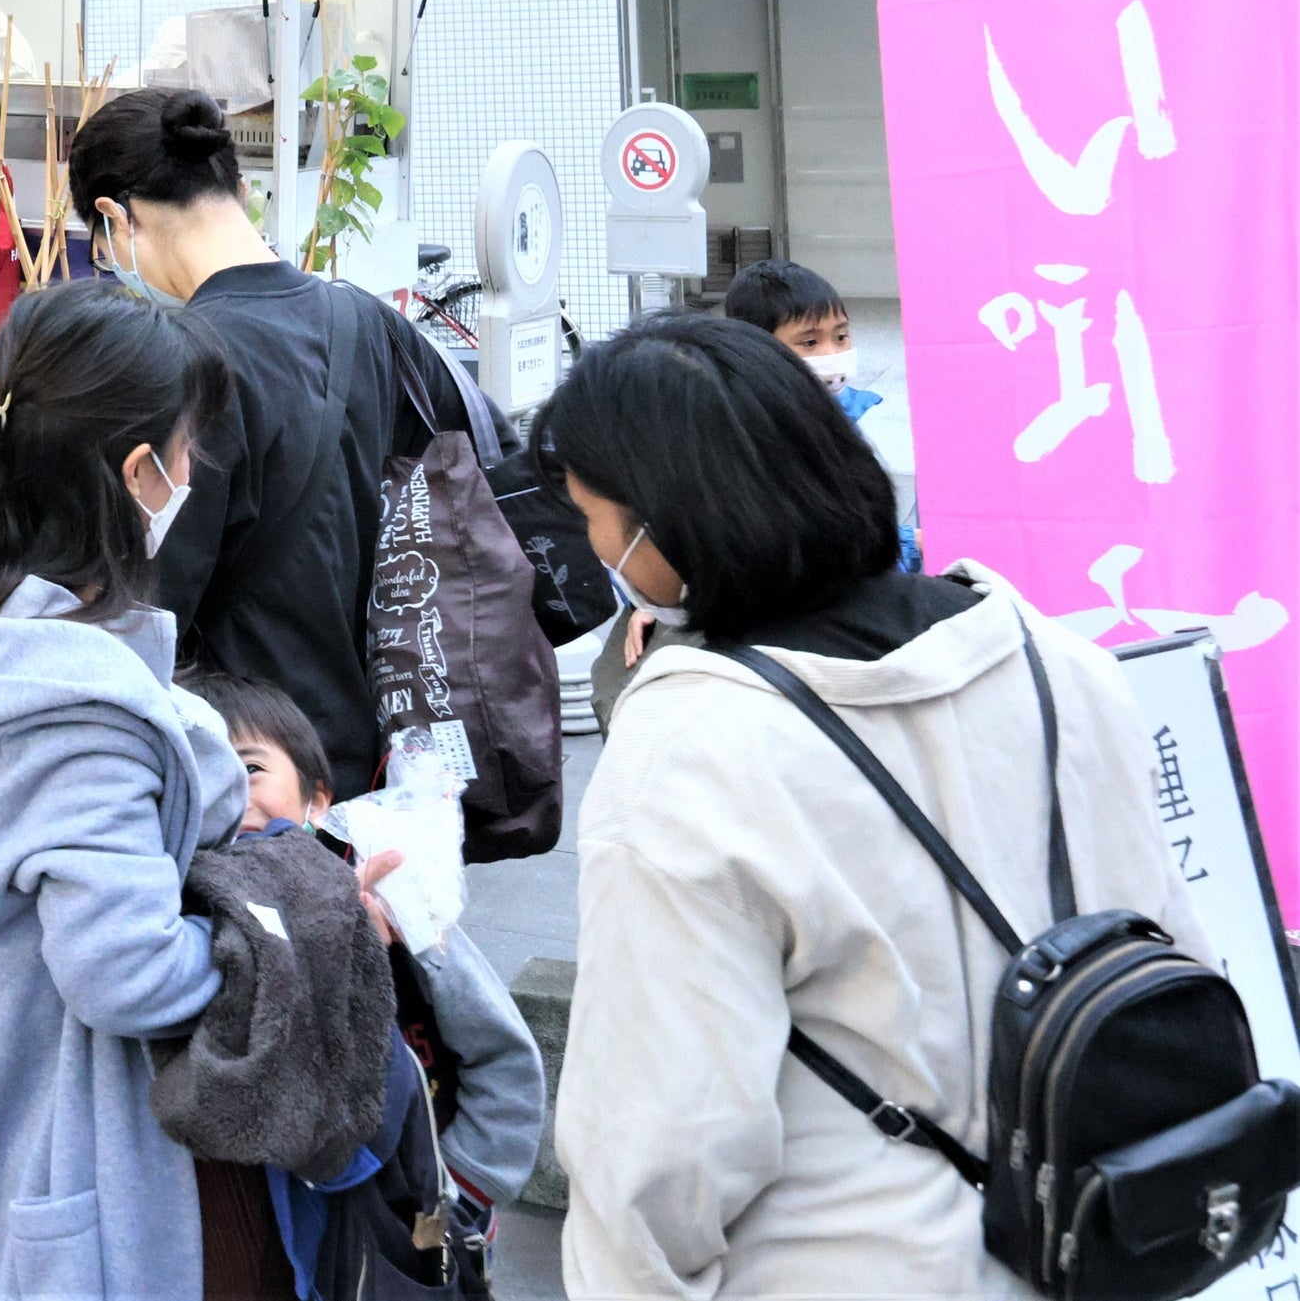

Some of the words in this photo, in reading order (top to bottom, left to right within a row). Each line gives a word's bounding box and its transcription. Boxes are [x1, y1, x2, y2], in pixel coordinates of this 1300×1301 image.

[410, 463, 433, 544] HAPPINESS
[390, 586, 411, 599] idea
[420, 627, 437, 663] Thank
[395, 671, 414, 682] DAYS
[425, 674, 443, 695] you
